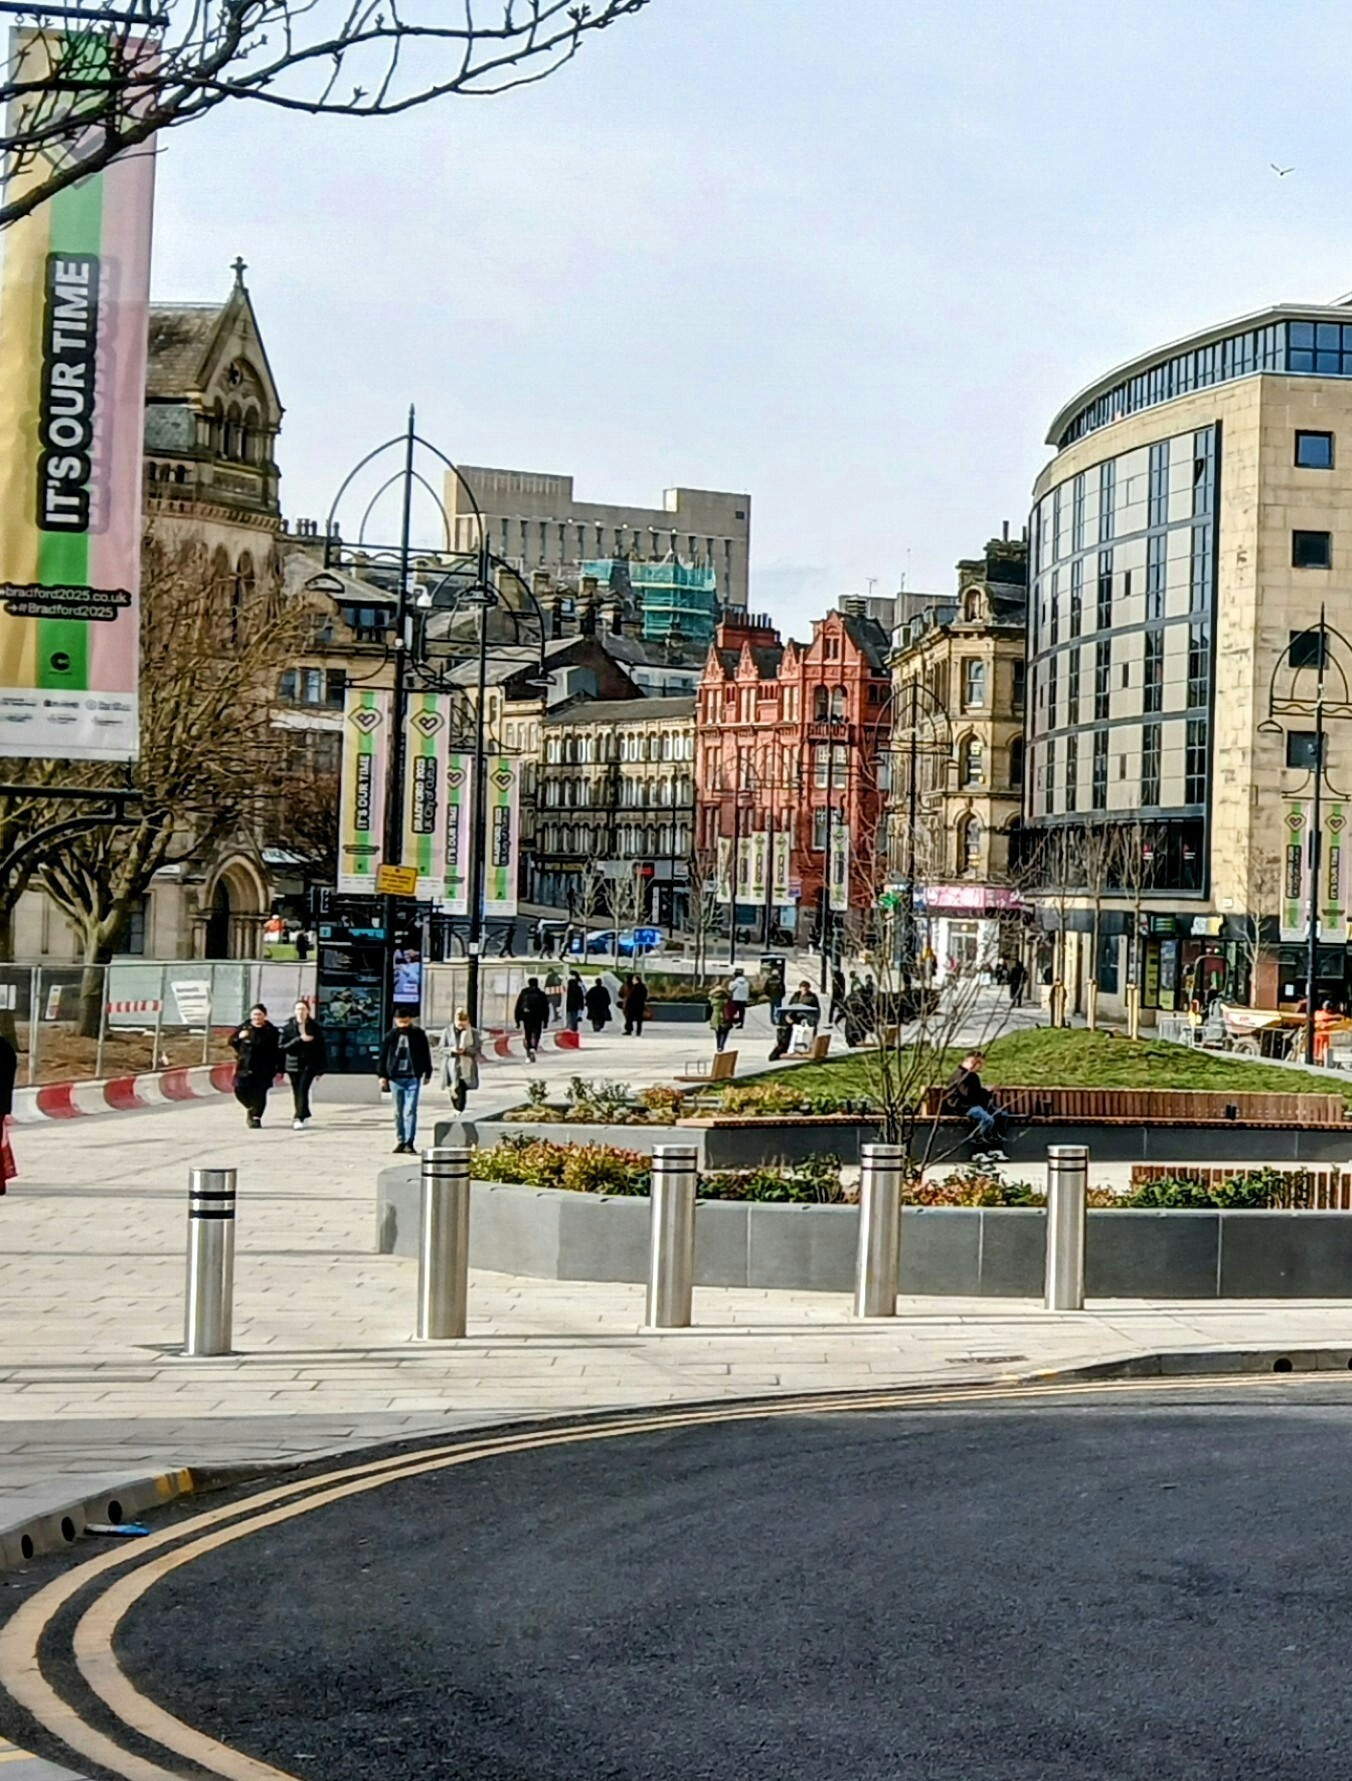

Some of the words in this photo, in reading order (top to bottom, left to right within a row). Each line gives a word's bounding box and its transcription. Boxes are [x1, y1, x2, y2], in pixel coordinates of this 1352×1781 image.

[52, 260, 90, 354] TIME
[48, 362, 86, 448] OUR
[46, 455, 82, 523] IT'S
[5, 586, 128, 603] bradford2025.co.uk
[18, 602, 114, 618] #Bradford2025
[358, 756, 370, 782] TIME
[415, 758, 426, 780] 2025
[357, 782, 369, 808] OUR
[424, 790, 434, 801] of
[413, 781, 424, 832] BRADFORD
[424, 801, 436, 819] City
[449, 805, 458, 826] TIME
[448, 827, 457, 847] OUR
[1330, 867, 1338, 884] OUR
